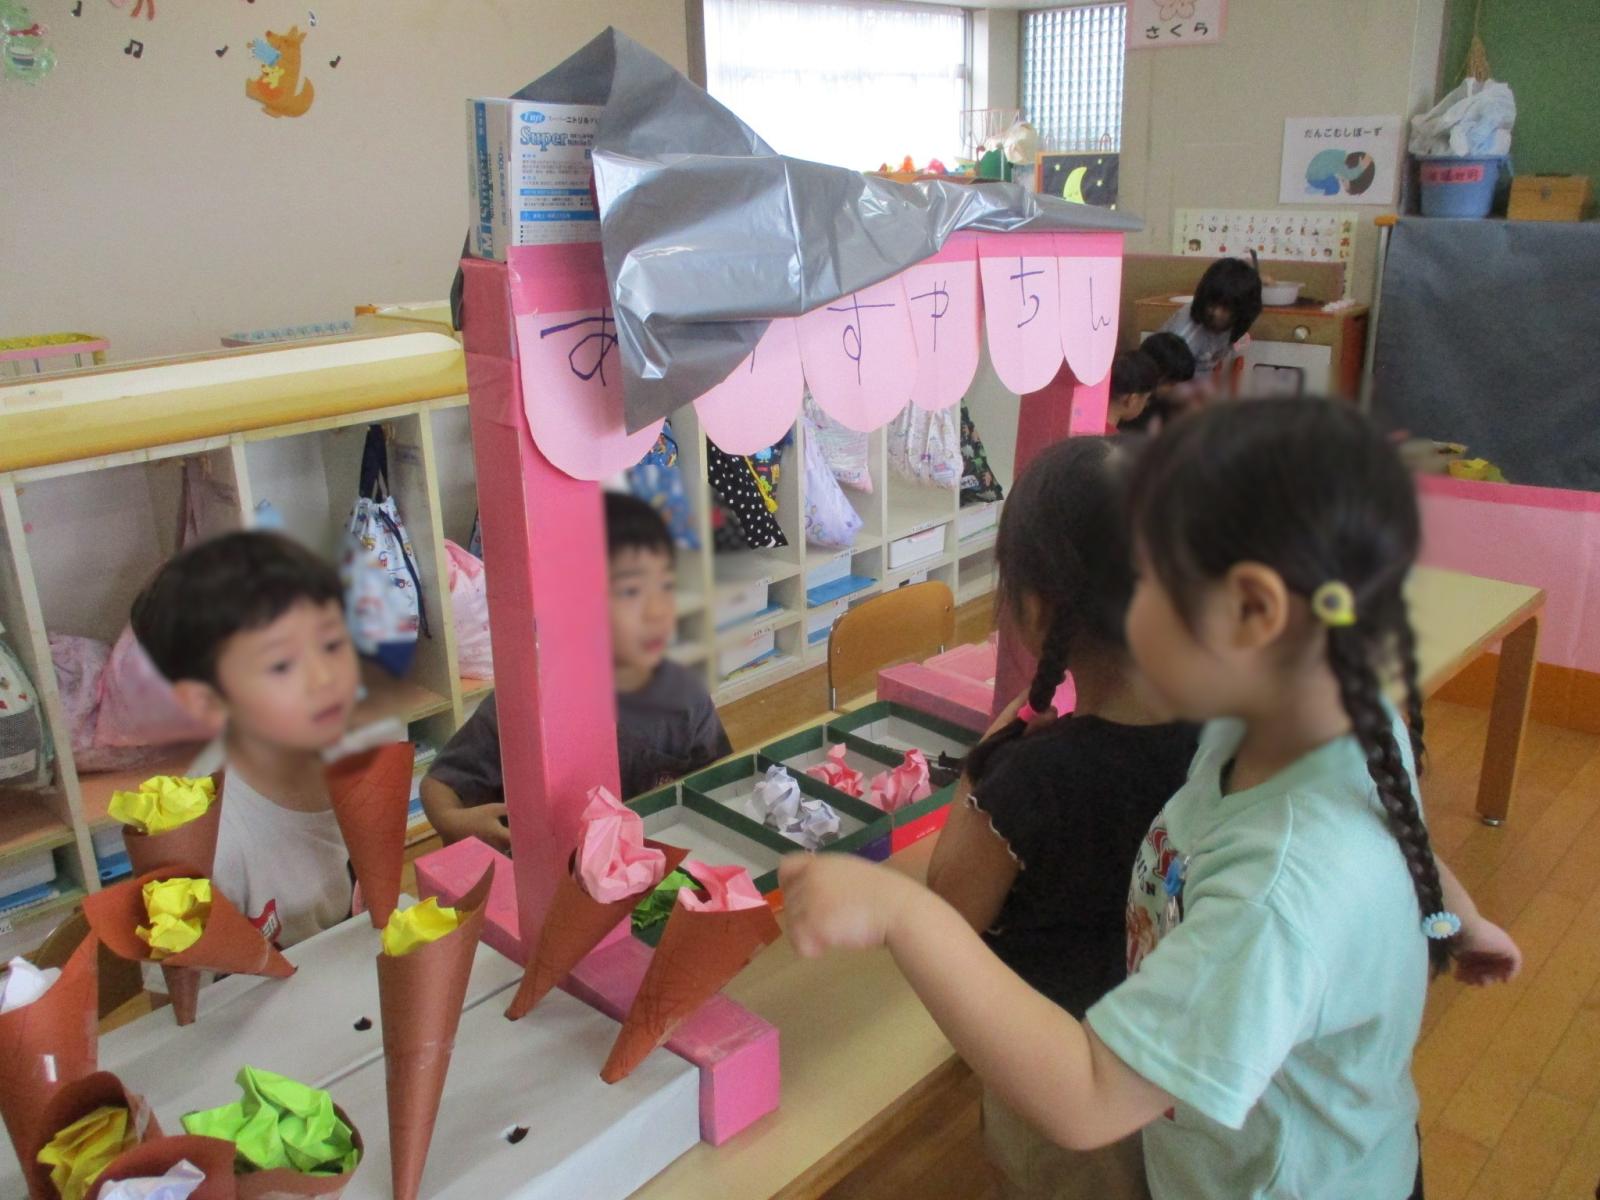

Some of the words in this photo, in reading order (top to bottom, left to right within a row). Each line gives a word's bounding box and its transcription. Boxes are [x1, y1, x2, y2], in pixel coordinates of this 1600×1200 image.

[1145, 22, 1208, 40] さくら
[520, 126, 568, 152] Super
